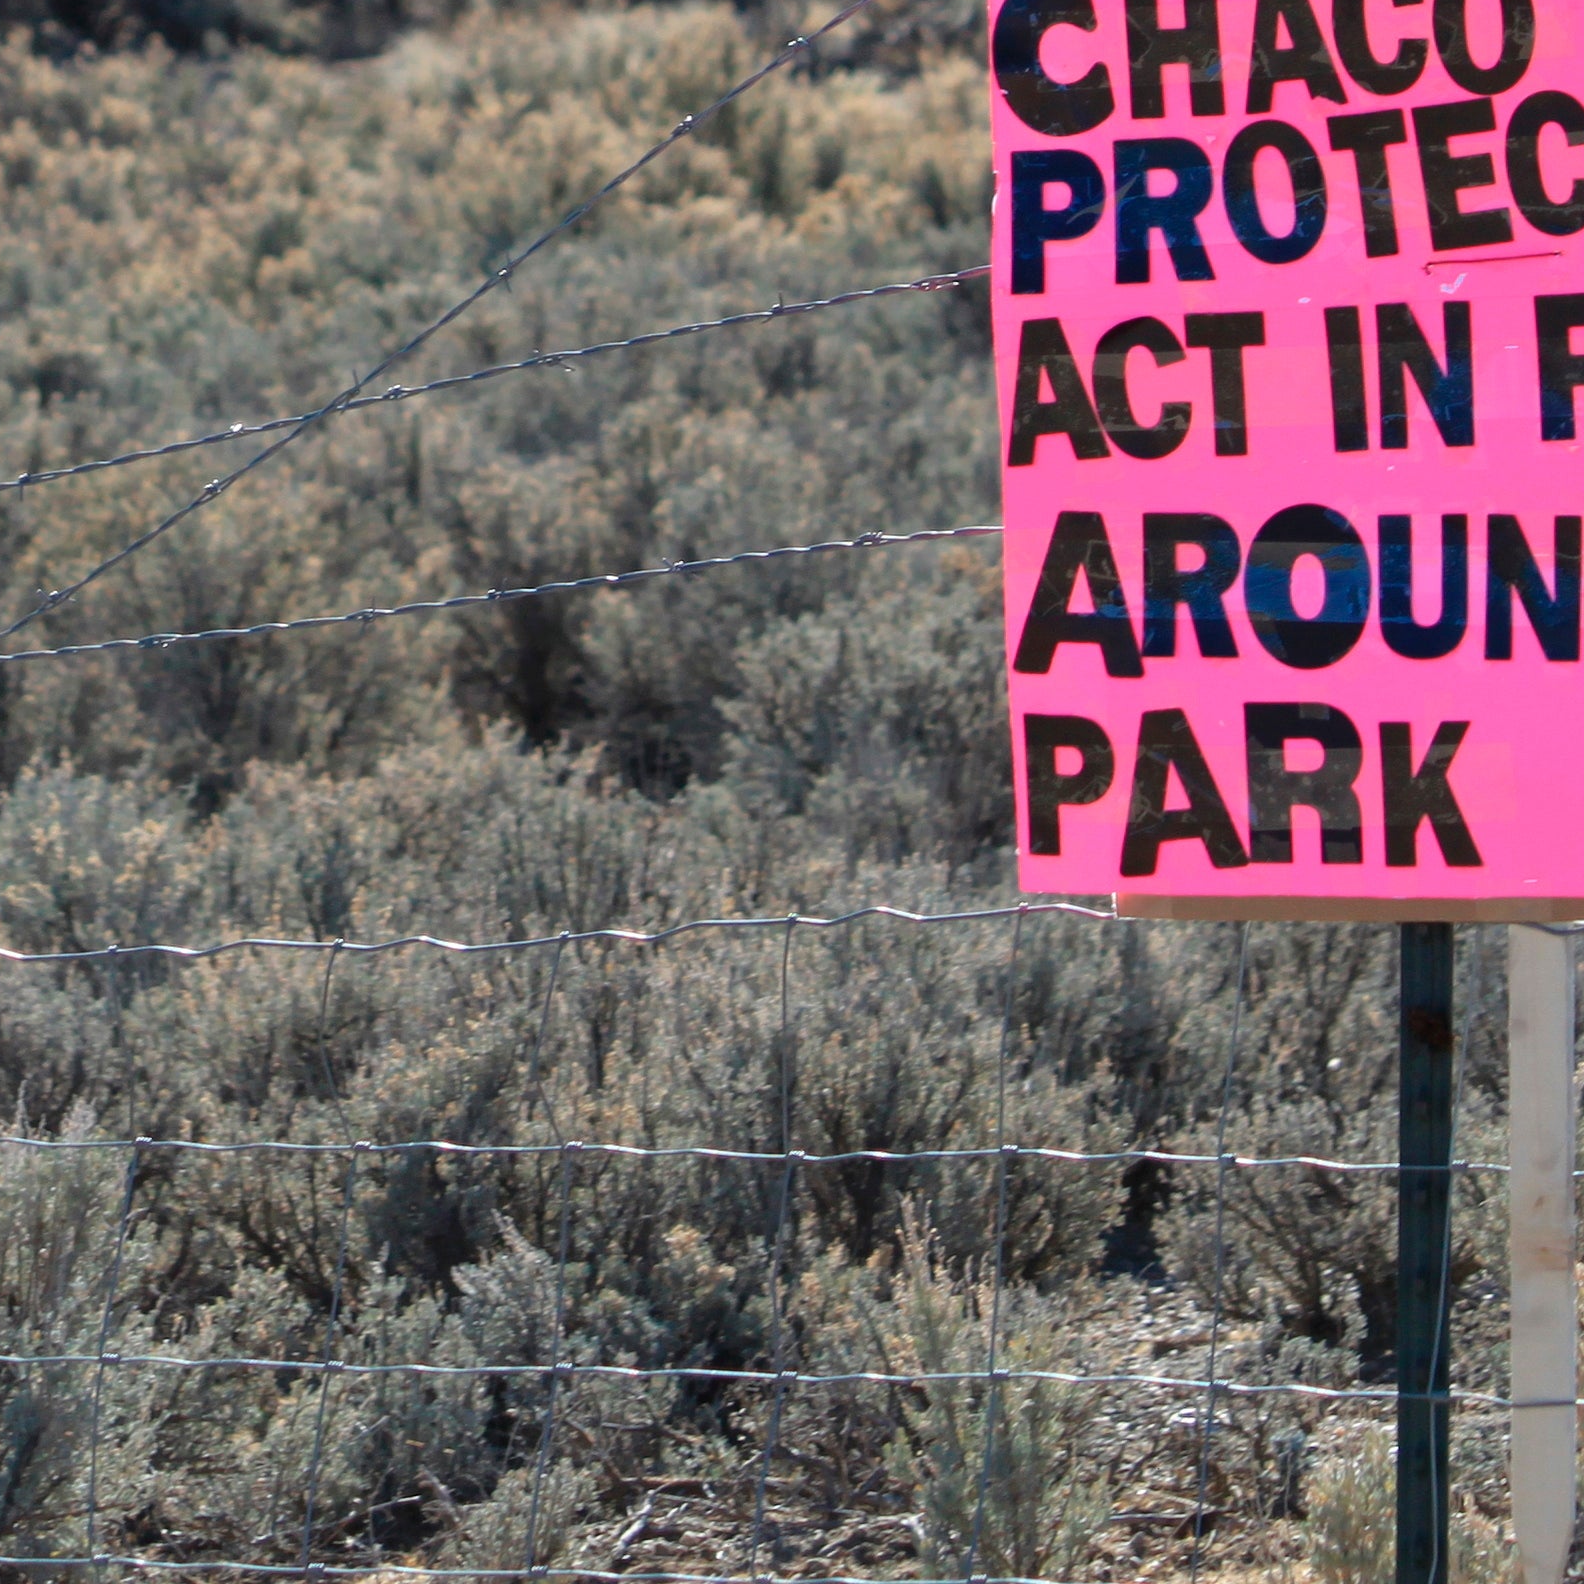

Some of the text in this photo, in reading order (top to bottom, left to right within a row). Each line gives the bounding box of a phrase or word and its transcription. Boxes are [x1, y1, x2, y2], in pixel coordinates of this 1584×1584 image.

[1008, 312, 1264, 466] ACT
[1325, 302, 1474, 452] IN
[1024, 702, 1481, 876] PARK
